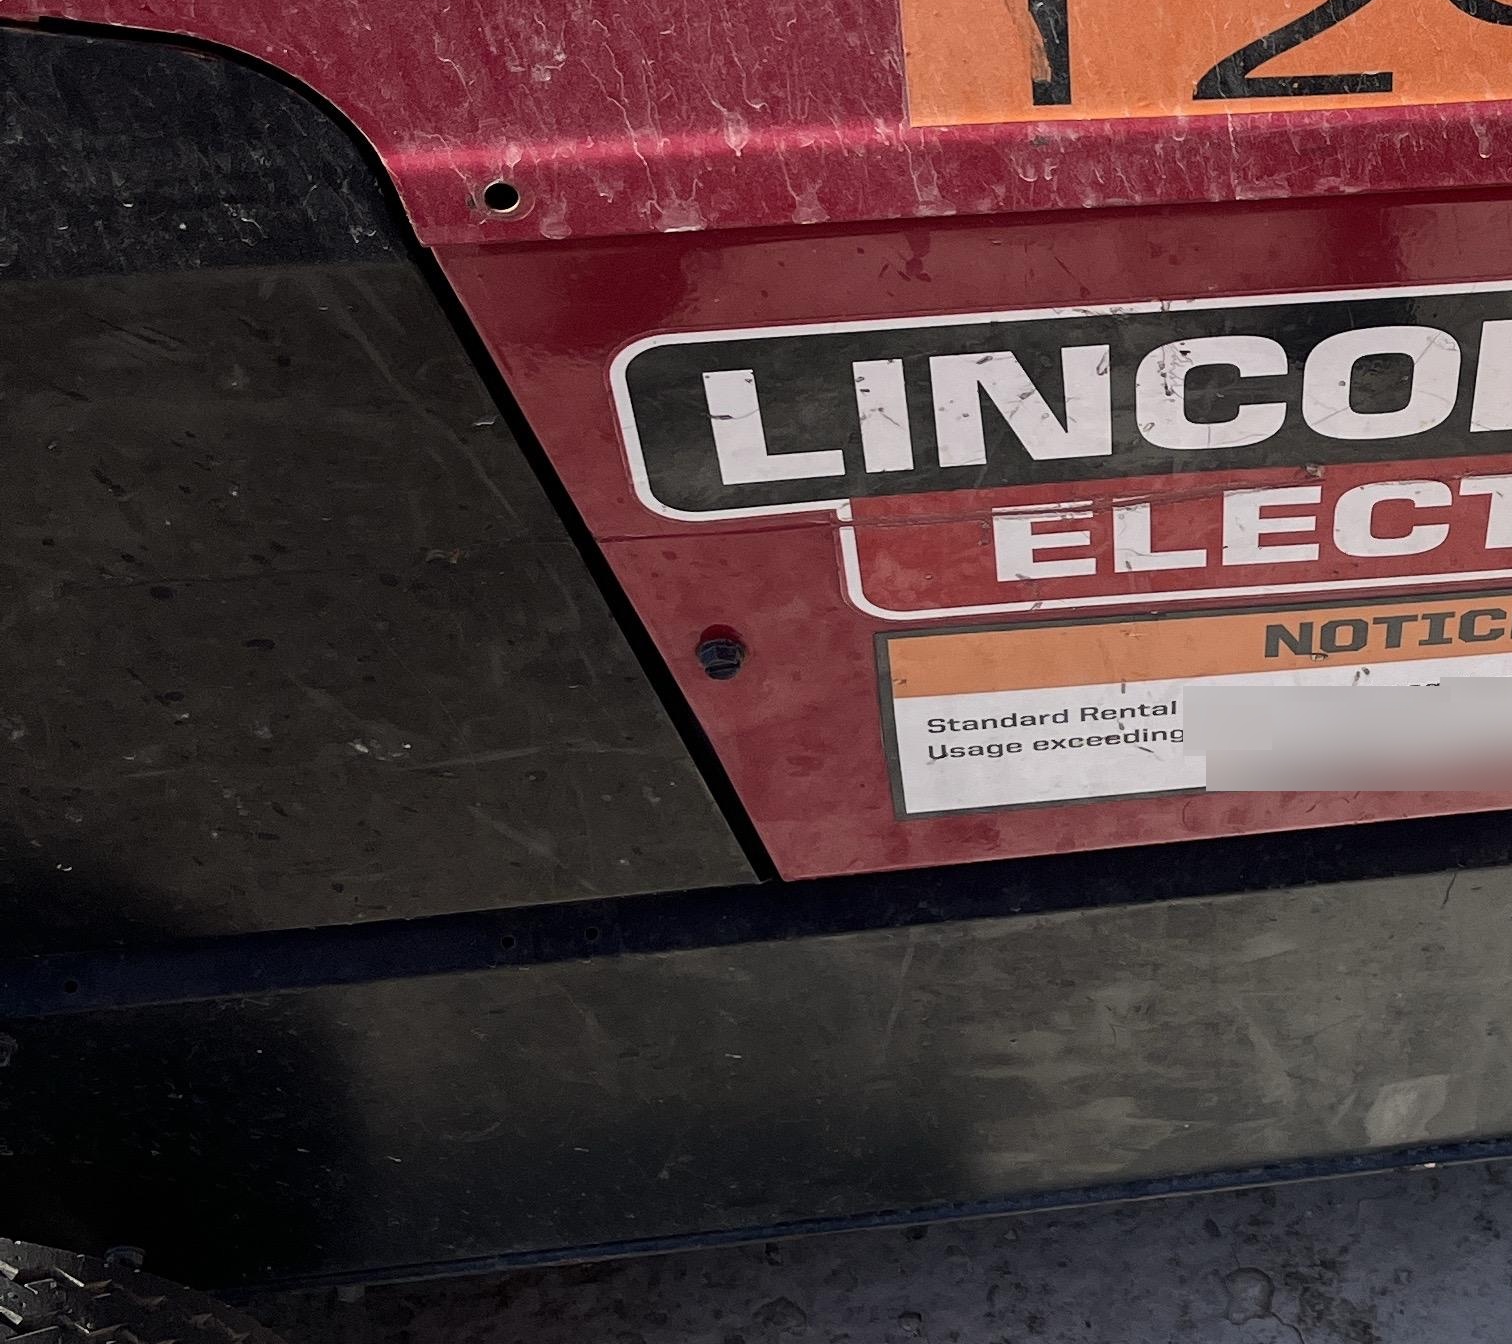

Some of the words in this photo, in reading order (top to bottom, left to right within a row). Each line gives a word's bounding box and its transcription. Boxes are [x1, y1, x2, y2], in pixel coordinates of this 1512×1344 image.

[926, 708, 1070, 734] Standard
[1079, 701, 1178, 723] Rental
[927, 741, 1023, 761] Usage
[1032, 727, 1184, 752] exceeding
